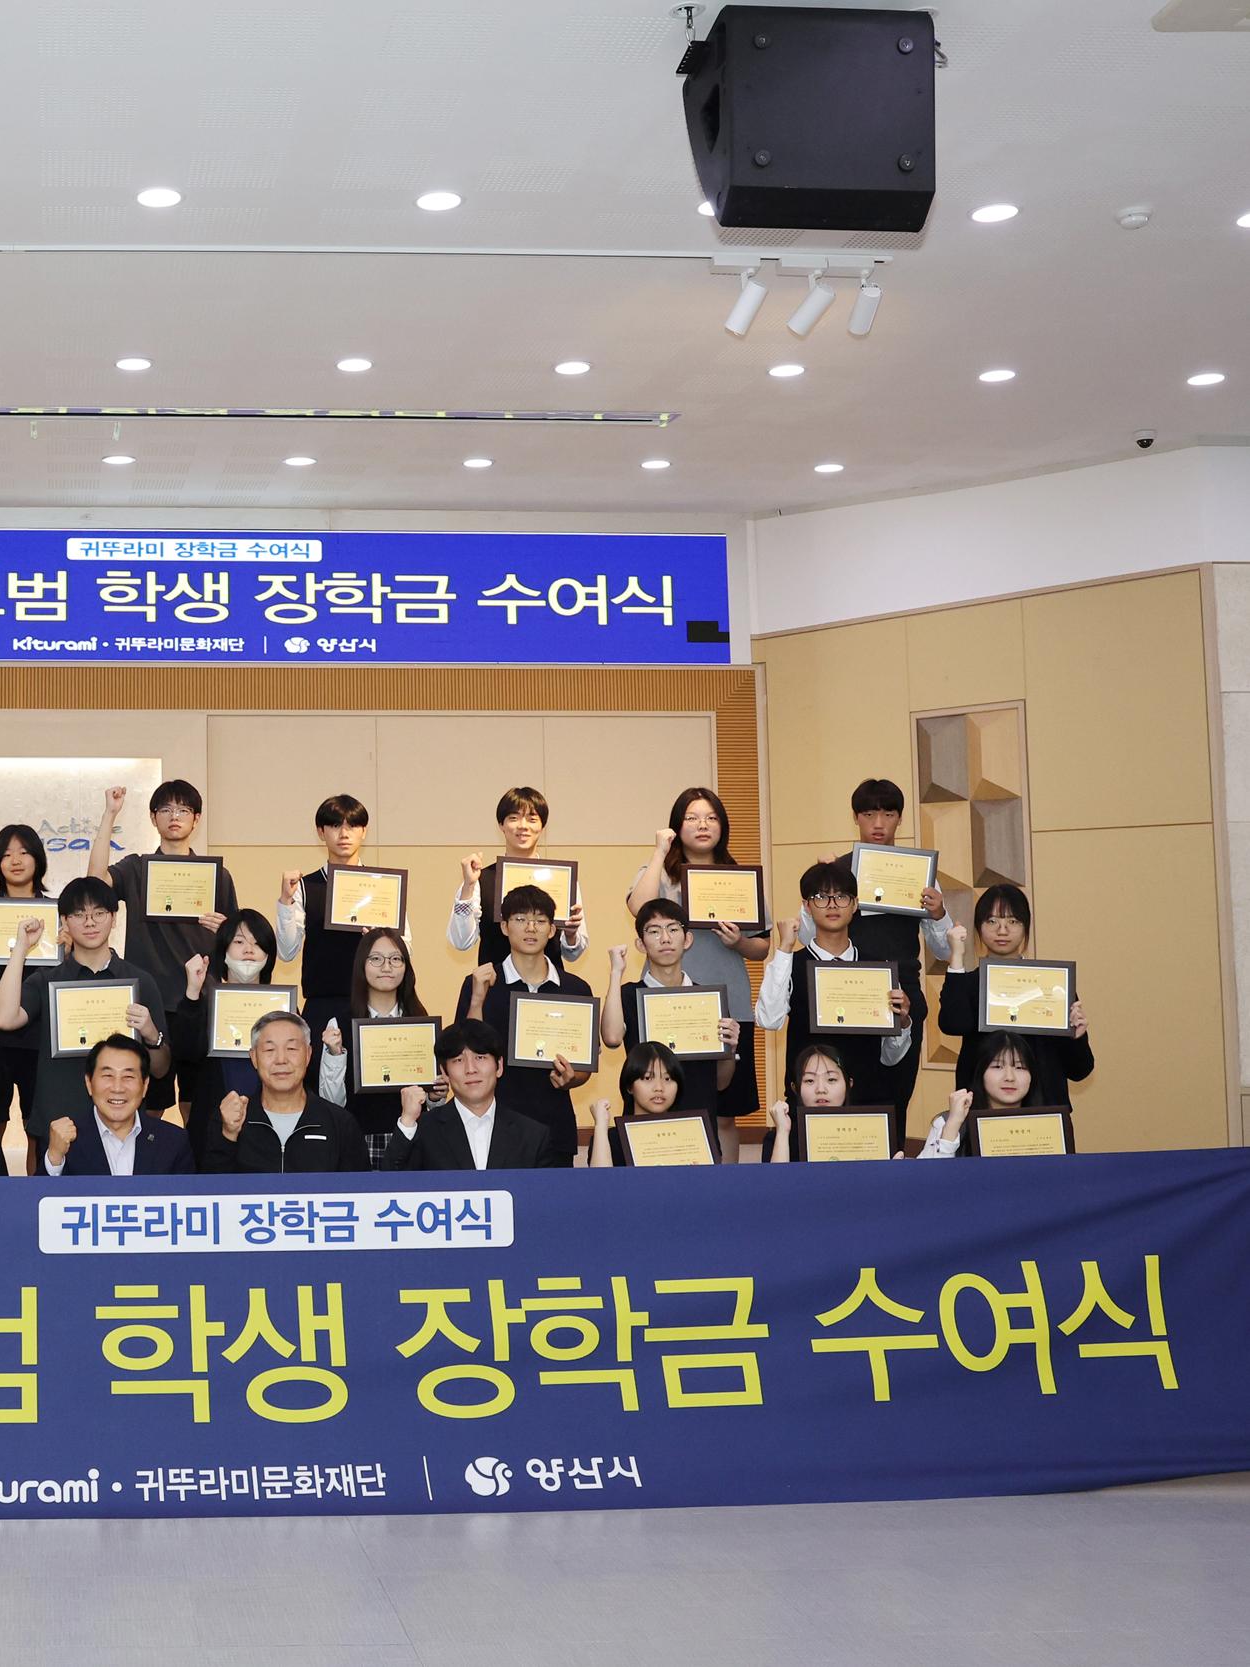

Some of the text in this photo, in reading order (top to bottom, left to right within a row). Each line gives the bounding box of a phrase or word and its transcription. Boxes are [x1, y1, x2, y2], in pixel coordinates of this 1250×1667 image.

[78, 540, 311, 561] 귀뚜라미 장학금 수여식
[96, 570, 230, 624] 학생
[254, 572, 457, 625] 장학금
[477, 573, 673, 626] 수여식
[12, 636, 245, 652] Kiturami 귀뚜라미문화재단
[316, 637, 377, 653] 양산시
[60, 1196, 494, 1248] 귀뚜라미 장학금 수여식
[96, 1282, 349, 1423] 학생
[397, 1276, 769, 1419] 장학금
[810, 1254, 1179, 1402] 수여식
[135, 1463, 387, 1502] 귀뚜라미문화재단
[525, 1455, 643, 1492] 양산시
